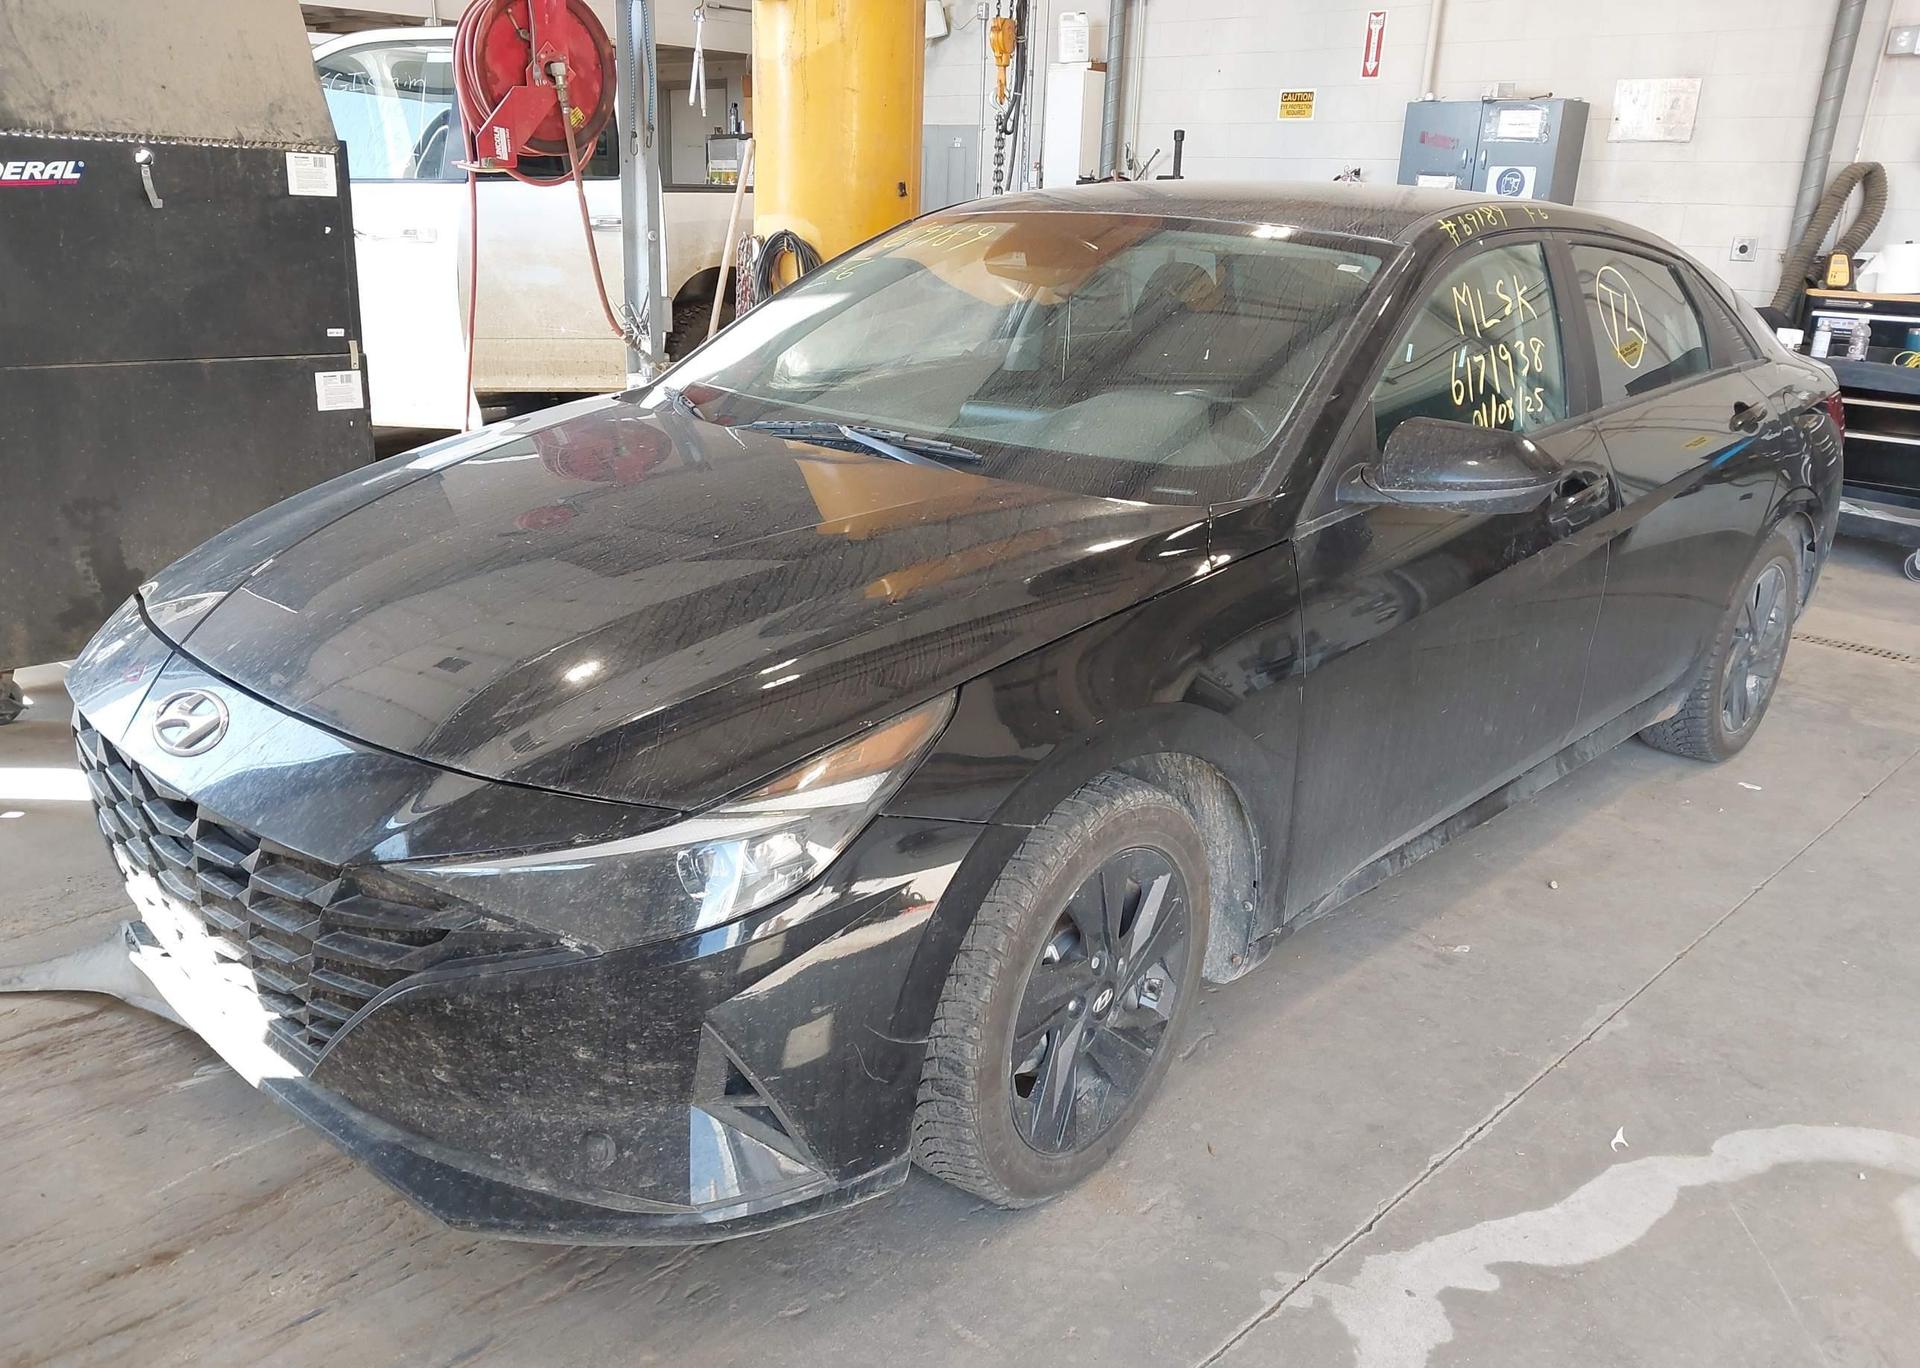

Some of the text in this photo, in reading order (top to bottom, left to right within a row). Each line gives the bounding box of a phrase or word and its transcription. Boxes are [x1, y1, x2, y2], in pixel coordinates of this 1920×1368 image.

[1282, 92, 1314, 102] CAUTION
[493, 126, 502, 160] LINCOLN
[1452, 274, 1538, 338] MLSK
[1451, 337, 1545, 406] 6171938
